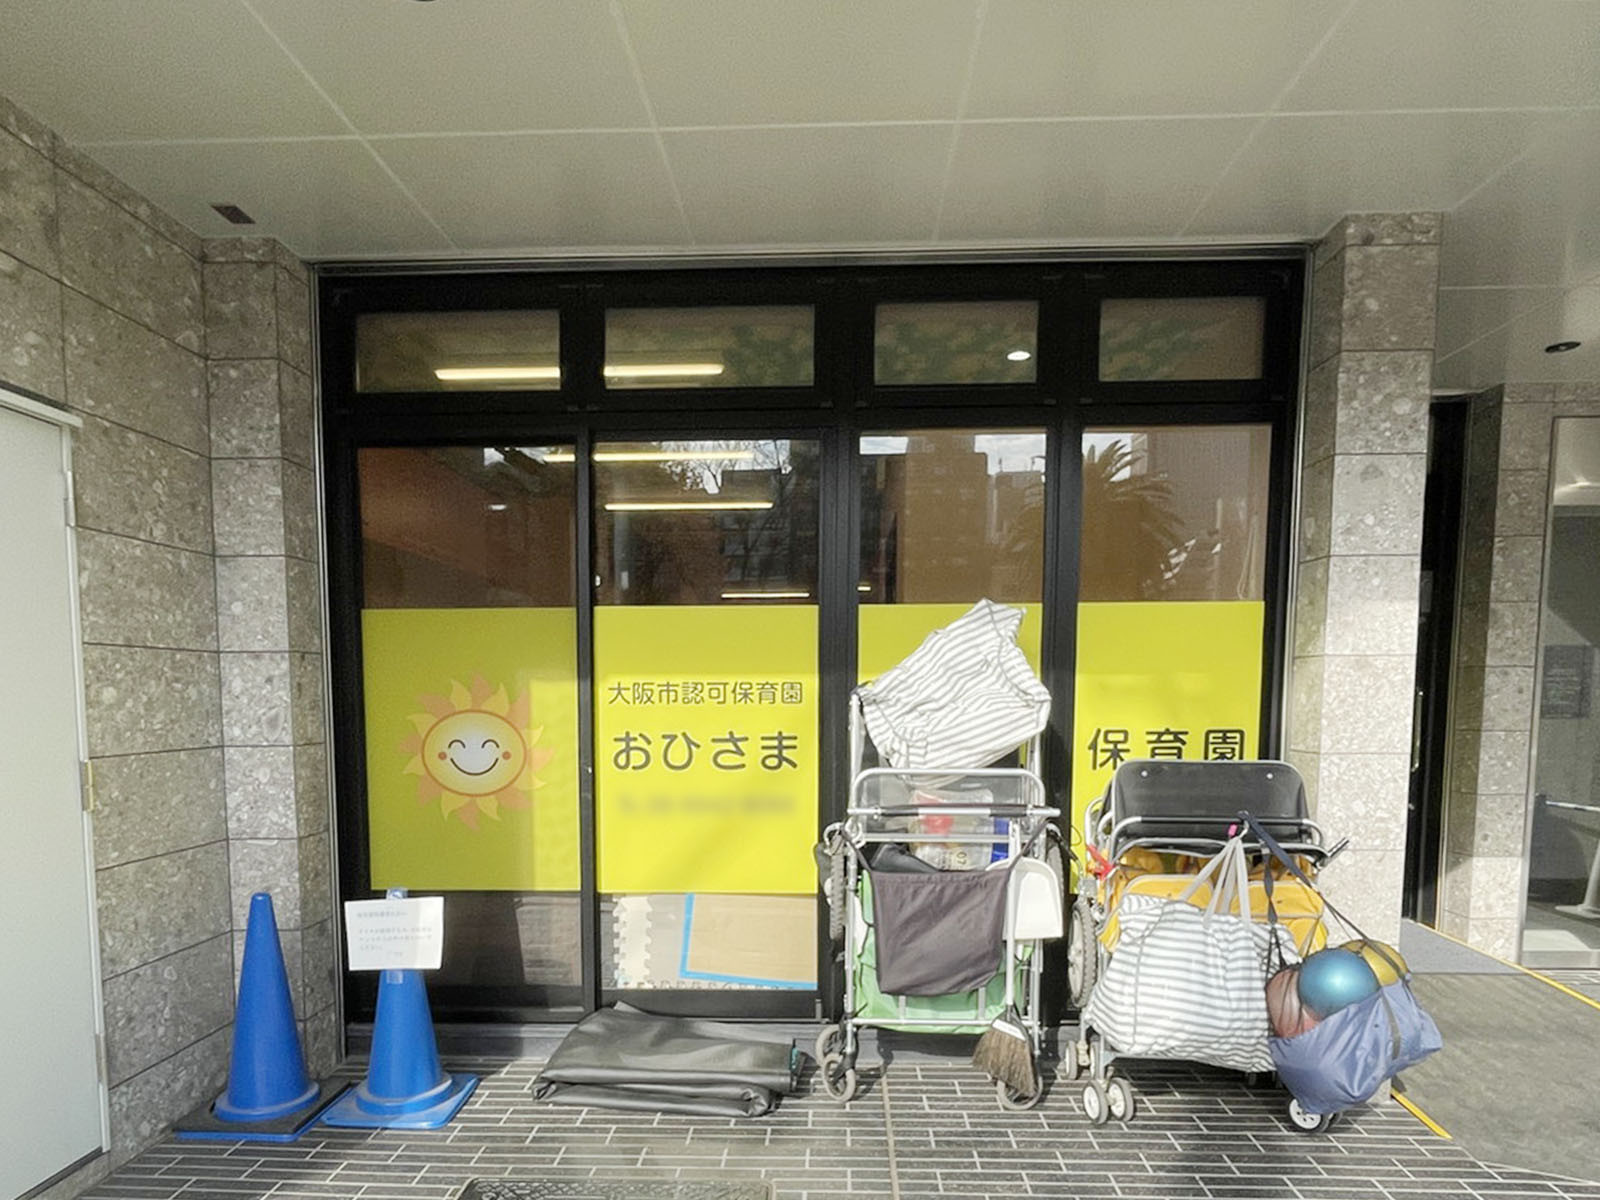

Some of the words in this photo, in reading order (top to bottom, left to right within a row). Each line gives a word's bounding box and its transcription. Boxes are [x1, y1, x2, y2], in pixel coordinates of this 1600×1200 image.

[608, 681, 803, 705] 大阪市認可保育園
[612, 730, 798, 771] おひさま
[1087, 727, 1246, 770] 保育園
